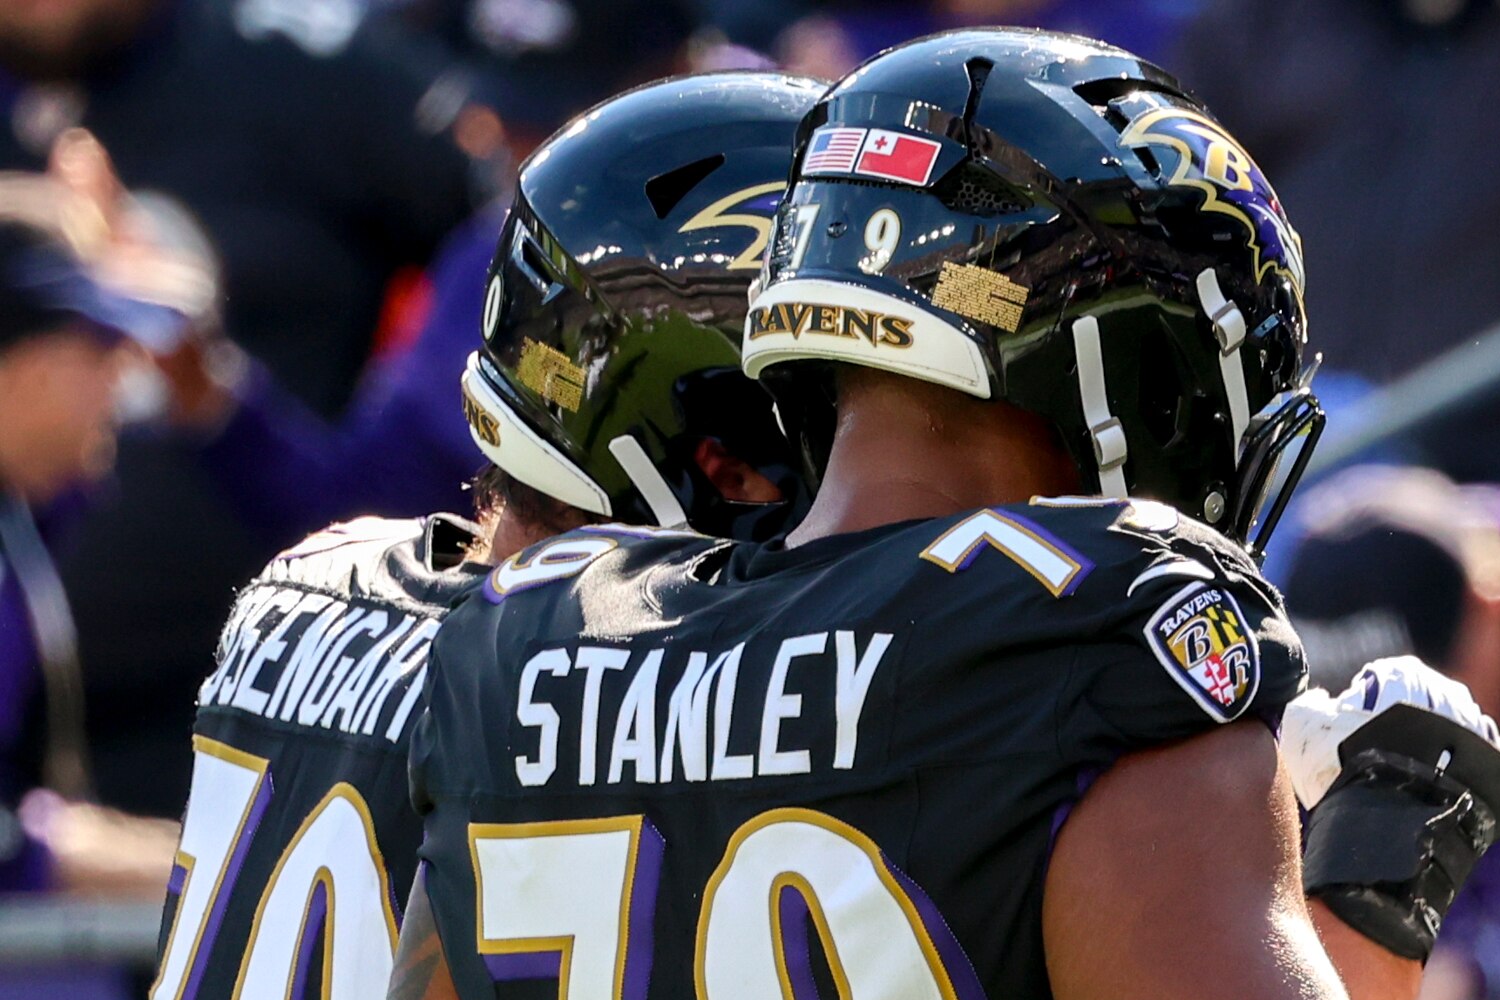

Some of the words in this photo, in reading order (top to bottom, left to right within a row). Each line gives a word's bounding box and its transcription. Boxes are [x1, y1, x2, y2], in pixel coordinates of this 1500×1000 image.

[749, 302, 915, 349] RAVENS
[1159, 588, 1222, 637] RAVENS
[515, 630, 894, 787] STANLEY
